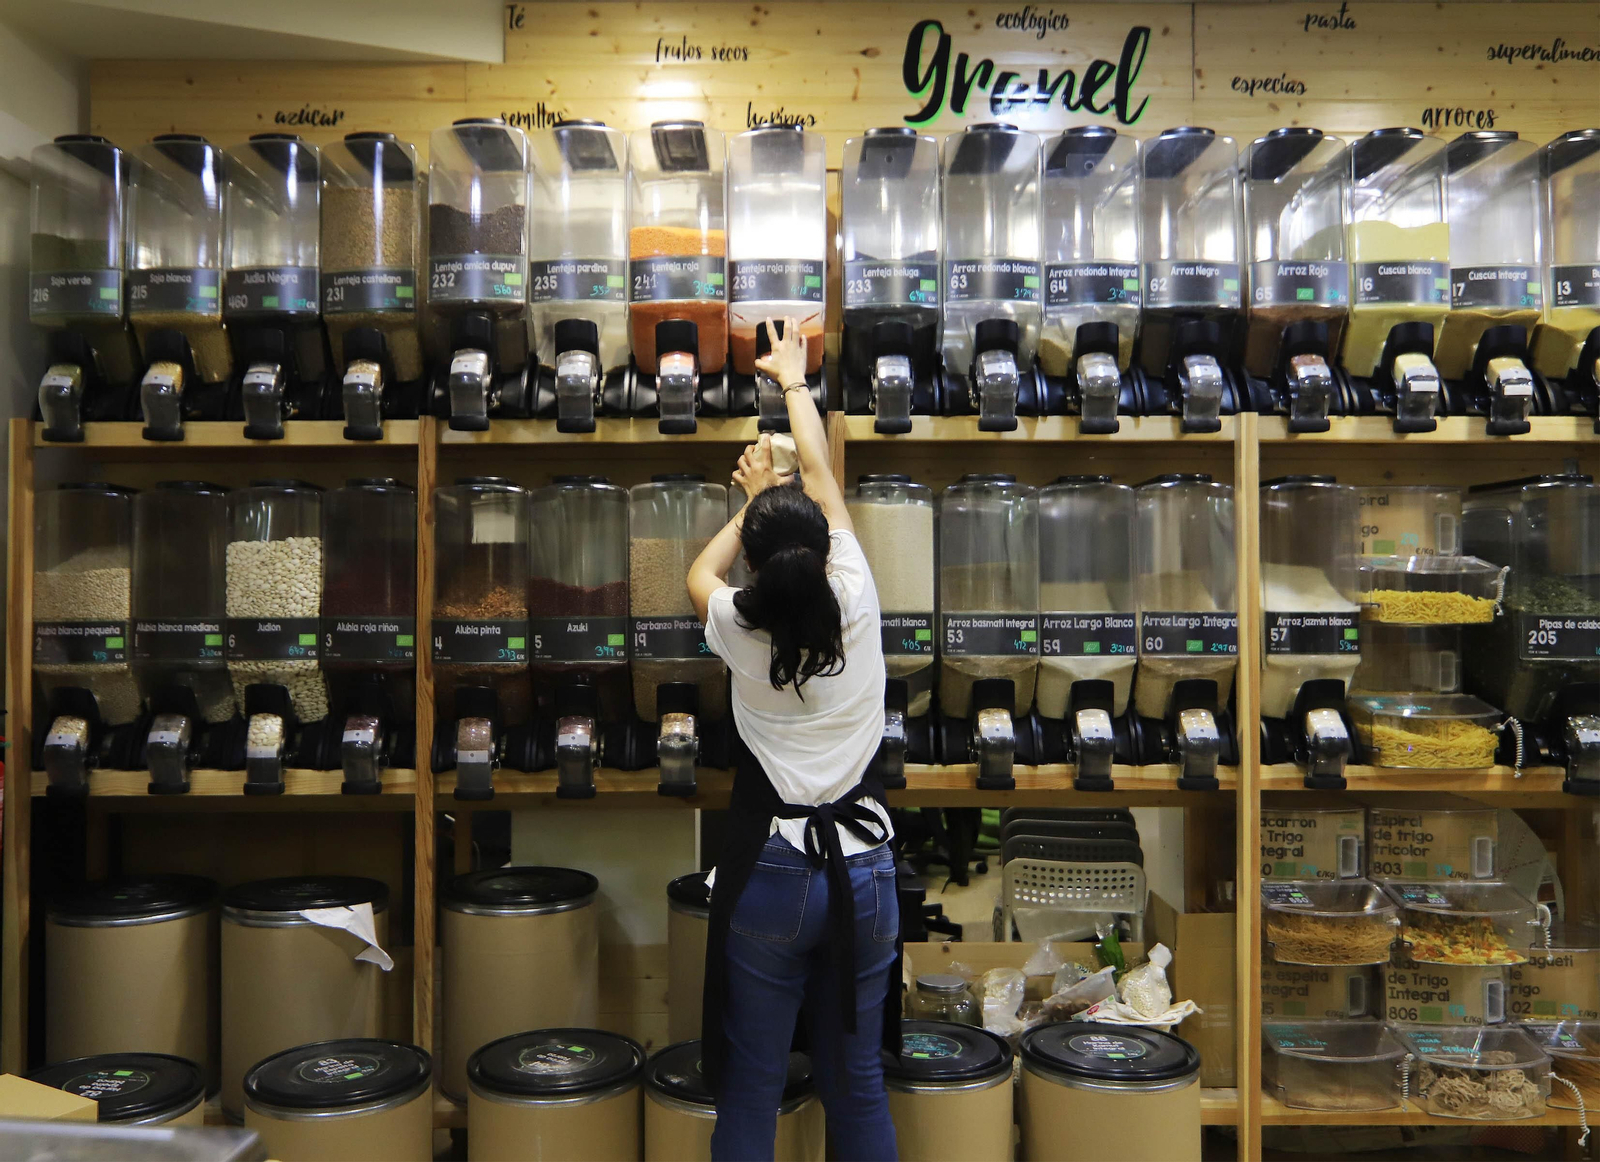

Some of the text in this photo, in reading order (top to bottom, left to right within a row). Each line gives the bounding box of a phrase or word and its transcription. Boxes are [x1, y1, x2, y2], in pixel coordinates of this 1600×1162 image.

[505, 4, 525, 30] Té
[995, 6, 1070, 39] ecológico
[1304, 2, 1356, 32] pasta
[655, 35, 750, 62] frutos secos
[1486, 38, 1600, 65] superalimen
[902, 20, 1152, 128] granel
[1231, 72, 1307, 97] especias
[274, 103, 345, 127] azúcar
[501, 102, 563, 129] semillas
[746, 101, 817, 128] harinas
[1421, 106, 1498, 129] arroces
[435, 264, 462, 272] Lenteja
[492, 261, 516, 272] dupuy
[547, 264, 607, 274] Lenteja pardina
[652, 262, 699, 272] Lenteja roja
[738, 264, 813, 274] Lenteja roja partida
[863, 268, 918, 278] Lenteja beluga
[953, 263, 1036, 274] Arroz redondo blanco
[1049, 269, 1072, 278] Arroz
[1075, 267, 1107, 276] redondo
[1170, 266, 1219, 276] Arroz Negro
[1277, 264, 1328, 278] Arroz Rojo
[1408, 265, 1431, 275] blanco
[150, 274, 191, 283] Soja blanca
[267, 273, 298, 284] Negra
[334, 275, 401, 285] Lenteja castellana
[432, 273, 454, 287] 232
[1592, 269, 1600, 278] Bu
[51, 276, 92, 286] Soja verde
[535, 276, 557, 289] 235
[634, 276, 657, 289] 241
[733, 276, 755, 289] 236
[847, 279, 871, 293] 233
[951, 276, 967, 288] 63
[1050, 280, 1067, 293] 64
[1150, 279, 1167, 292] 62
[1360, 278, 1372, 291] 16
[131, 286, 147, 298] 215
[327, 288, 344, 301] 231
[1256, 287, 1272, 301] 65
[1453, 283, 1465, 297] 17
[1558, 281, 1571, 295] 13
[33, 289, 49, 302] 216
[1358, 495, 1389, 507] piral
[136, 623, 219, 632] Alubia blanca mediana
[337, 623, 358, 631] Alubia
[360, 624, 376, 633] roja
[567, 623, 588, 632] Azuki
[636, 620, 705, 630] Garbanzo Pedros
[881, 618, 926, 627] smati blanco
[947, 619, 971, 627] Arroz
[972, 619, 1004, 628] basmati
[1043, 618, 1133, 631] Arroz Largo Blanco
[1144, 616, 1238, 629] Arroz Largo Integra
[1277, 617, 1301, 626] Arroz
[1329, 617, 1351, 626] blanco
[1539, 619, 1562, 630] Pipas
[1565, 620, 1576, 629] de
[37, 626, 120, 636] Alubia blanca pequeña
[455, 625, 501, 636] Alubia pinta
[947, 630, 964, 643] 53
[1270, 628, 1287, 641] 57
[36, 638, 42, 650] 2
[229, 634, 235, 648] 6
[325, 634, 332, 646] 3
[435, 636, 442, 649] 4
[535, 635, 541, 648] 5
[634, 633, 646, 646] 19
[1146, 637, 1163, 651] 60
[1528, 631, 1557, 645] 205
[1043, 639, 1060, 653] 59
[1373, 815, 1422, 829] Espiral
[1267, 830, 1303, 843] Trigo
[1373, 829, 1433, 843] de trigo
[1260, 846, 1304, 859] tegral
[1373, 845, 1429, 857] tricolor
[1373, 862, 1402, 875] 803
[1526, 956, 1573, 969] agueti
[1388, 974, 1448, 989] de Trigo
[1261, 985, 1308, 998] ntegral
[1388, 987, 1449, 1003] Integral
[1511, 985, 1540, 997] rigo
[1262, 1002, 1274, 1015] 15
[1388, 1007, 1417, 1020] 806
[1512, 1002, 1531, 1014] 02
